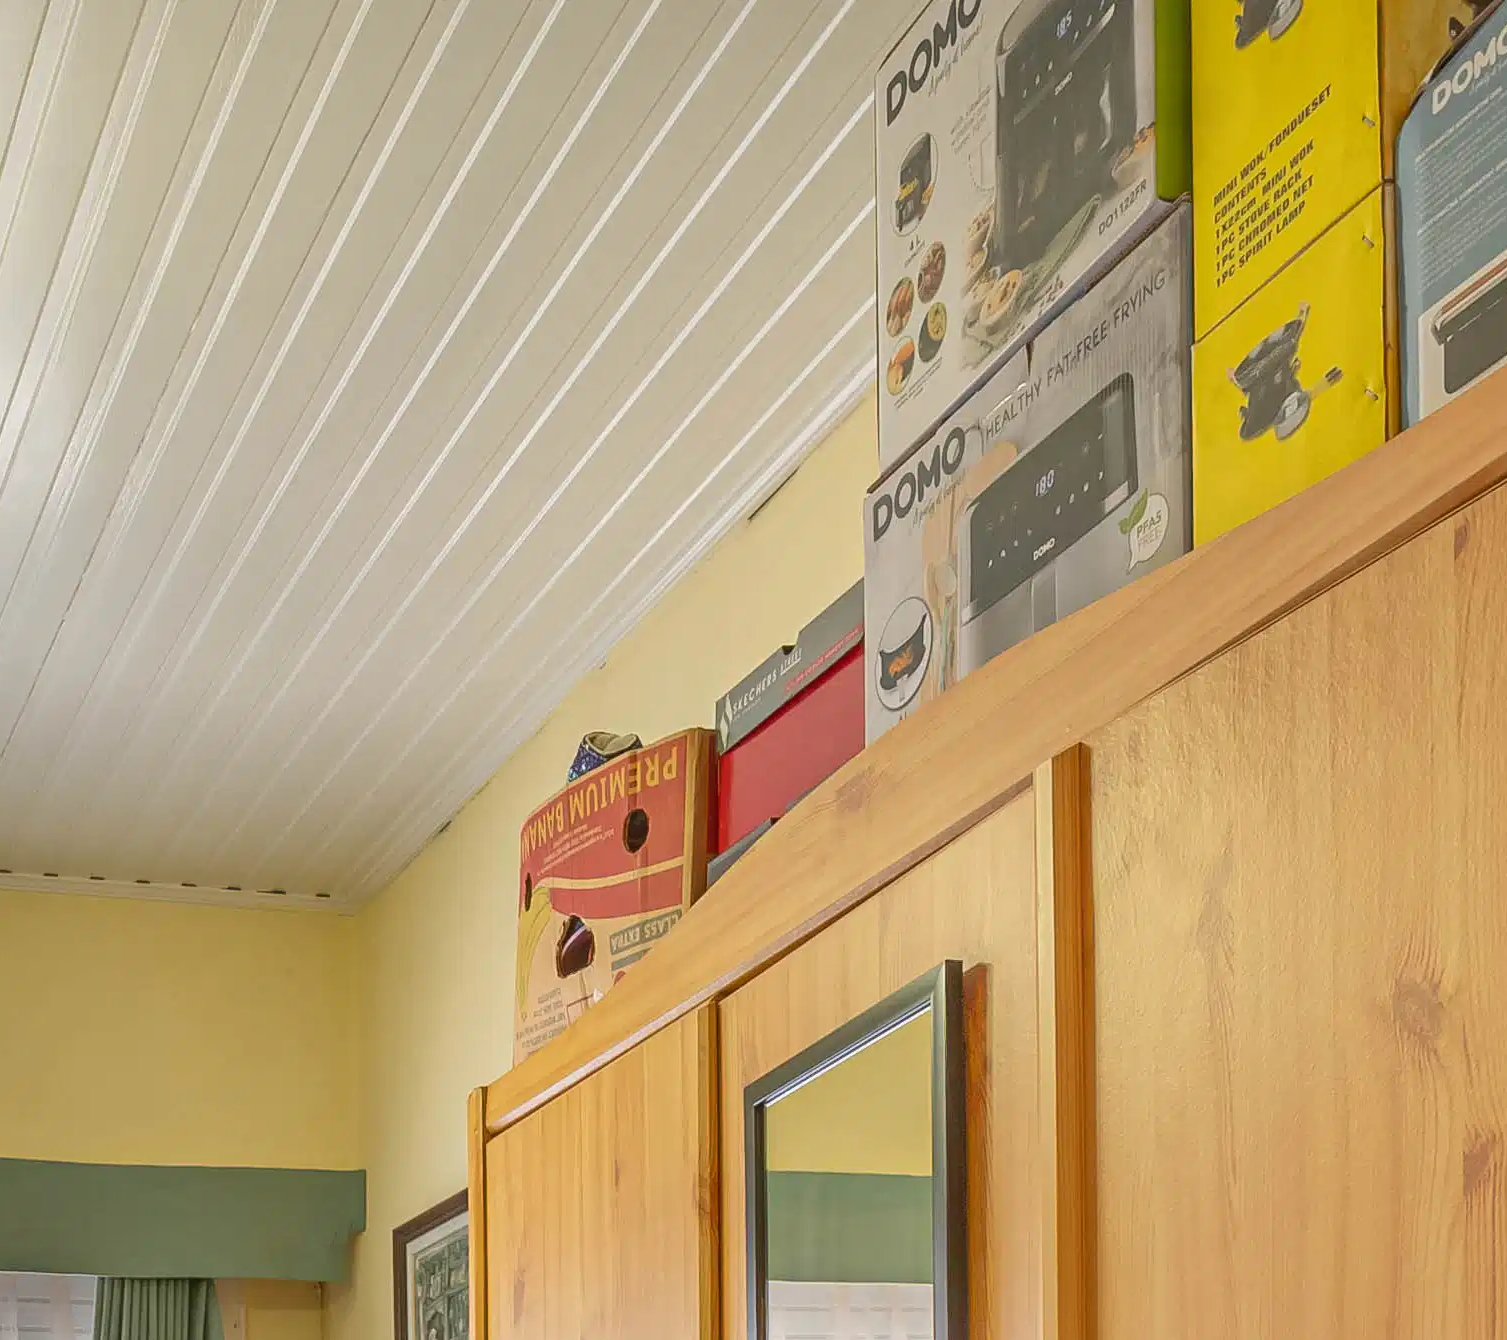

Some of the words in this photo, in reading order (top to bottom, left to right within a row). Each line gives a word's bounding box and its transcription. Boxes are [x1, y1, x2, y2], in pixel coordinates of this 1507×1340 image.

[886, 0, 982, 126] DOMO
[1213, 176, 1238, 207] MINI
[1214, 167, 1267, 224] CONTENTS
[1262, 165, 1287, 196] MINI
[1289, 138, 1314, 169] WOK
[1098, 178, 1147, 236] DO1122FR
[1238, 198, 1290, 251] CHROMED
[1292, 174, 1314, 201] NET
[1238, 198, 1270, 235] STOVE
[1238, 230, 1273, 268] SPIRIT
[1276, 200, 1305, 234] LAMP
[986, 377, 1043, 441] HEALTHY
[1047, 321, 1108, 387] FAT-FREE
[1113, 268, 1167, 329] FRYING
[873, 427, 965, 541] DOMO
[1033, 537, 1056, 560] DOMO
[1136, 510, 1162, 538] PFAS
[733, 670, 777, 715] SKECHERS
[569, 746, 678, 824] PREMIUM
[610, 927, 640, 953] EXTRA
